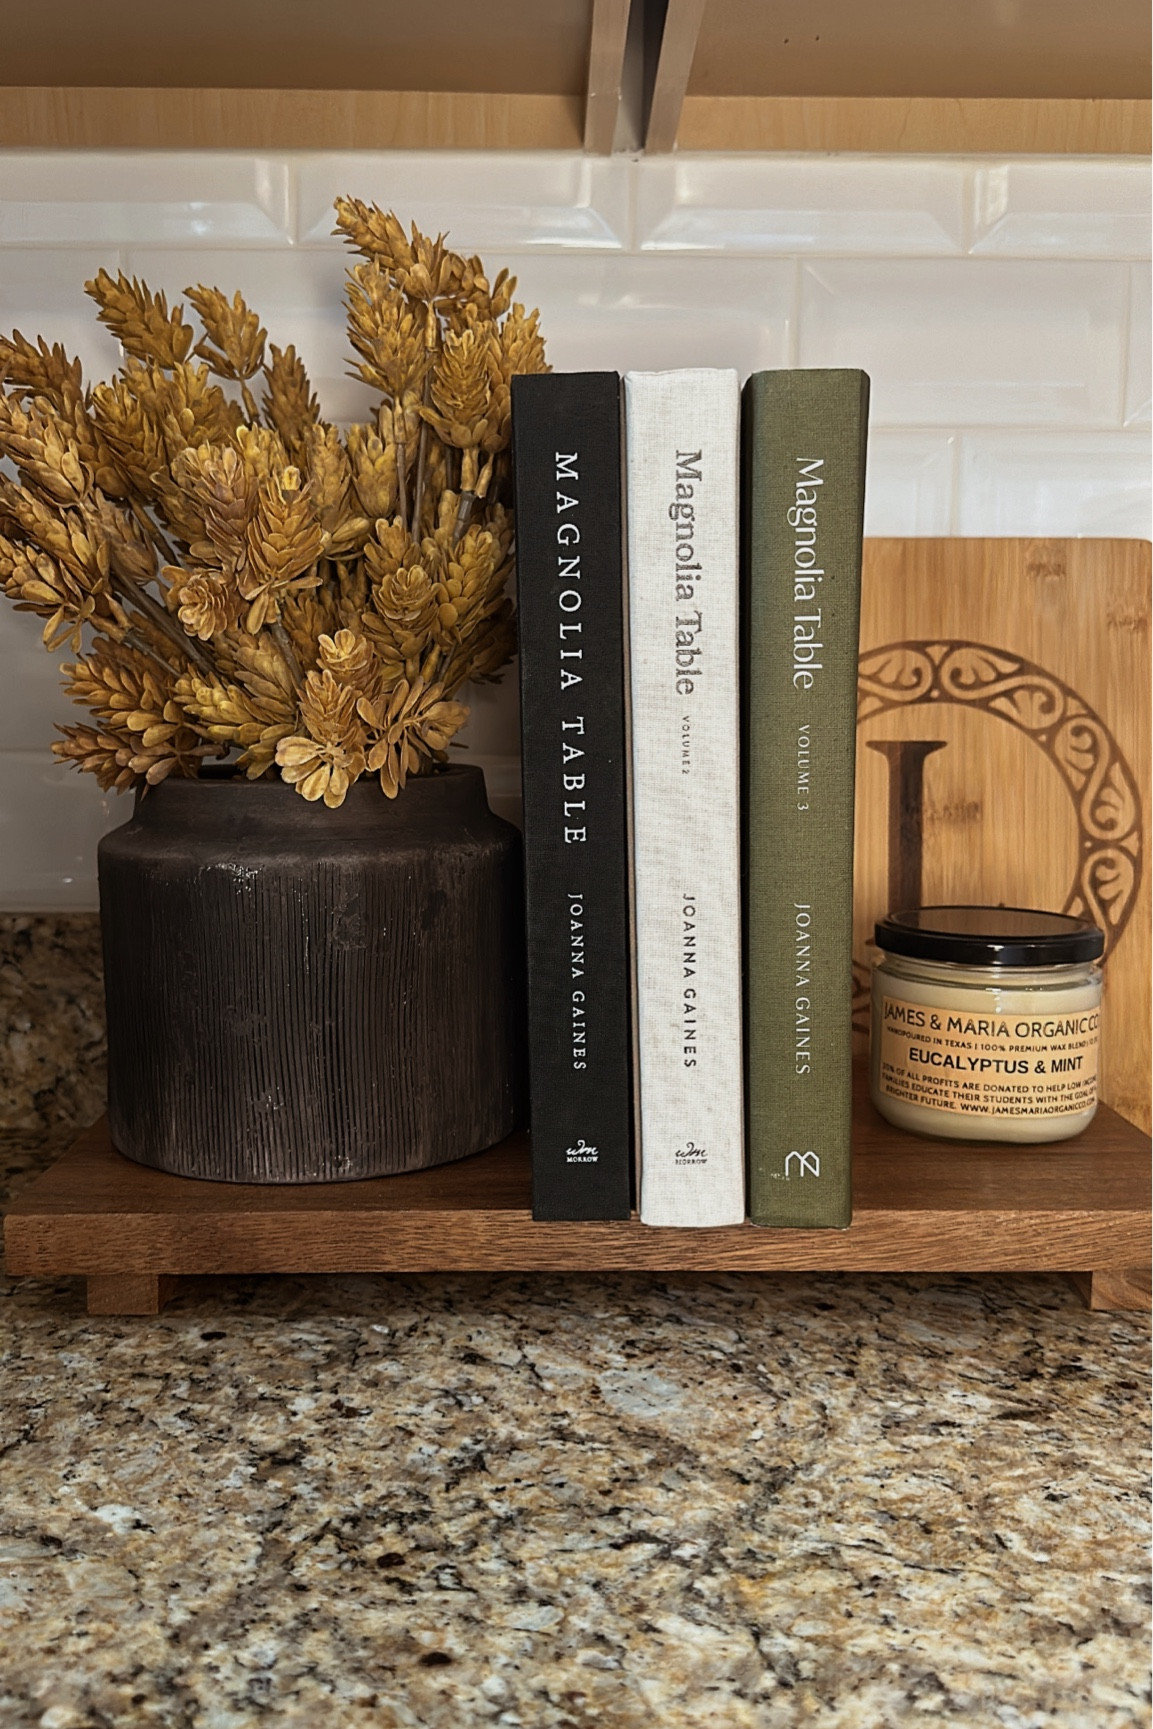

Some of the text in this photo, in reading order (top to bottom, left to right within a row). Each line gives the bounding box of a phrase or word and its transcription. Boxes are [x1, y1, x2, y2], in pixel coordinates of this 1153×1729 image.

[669, 450, 702, 694] Magnolia Table
[787, 458, 824, 689] Magnolia Table
[556, 452, 586, 843] MAGNOLIA TABLE
[681, 715, 691, 765] VOLUME
[796, 724, 810, 811] VOLUME 3
[568, 894, 586, 1069] JOANNA GAINES
[683, 894, 696, 1067] JOANNA GAINES
[794, 903, 810, 1073] JOANNA GAINES
[884, 1002, 925, 1027] JAMES
[930, 1014, 941, 1030] &
[947, 1016, 1010, 1037] MARIA
[907, 1072, 920, 1081] ALL
[922, 1075, 959, 1088] PROFITS
[962, 1082, 981, 1091] ARE
[983, 1084, 1029, 1093] DONATED
[1032, 1085, 1043, 1093] TO
[1046, 1083, 1066, 1092] HELP
[1067, 1081, 1081, 1090] LOW
[909, 1047, 1029, 1074] EUCALYPTUS
[1034, 1060, 1046, 1073] &
[1051, 1056, 1084, 1073] MINT
[933, 1037, 942, 1045] IN
[945, 1039, 971, 1049] TEXAS
[911, 1083, 949, 1098] EDUCATE
[953, 1090, 980, 1101] THEIR
[983, 1095, 1033, 1104] STUDENTS
[1036, 1095, 1057, 1104] WITH
[1060, 1092, 1073, 1102] THE
[1074, 1089, 1088, 1100] GOAL
